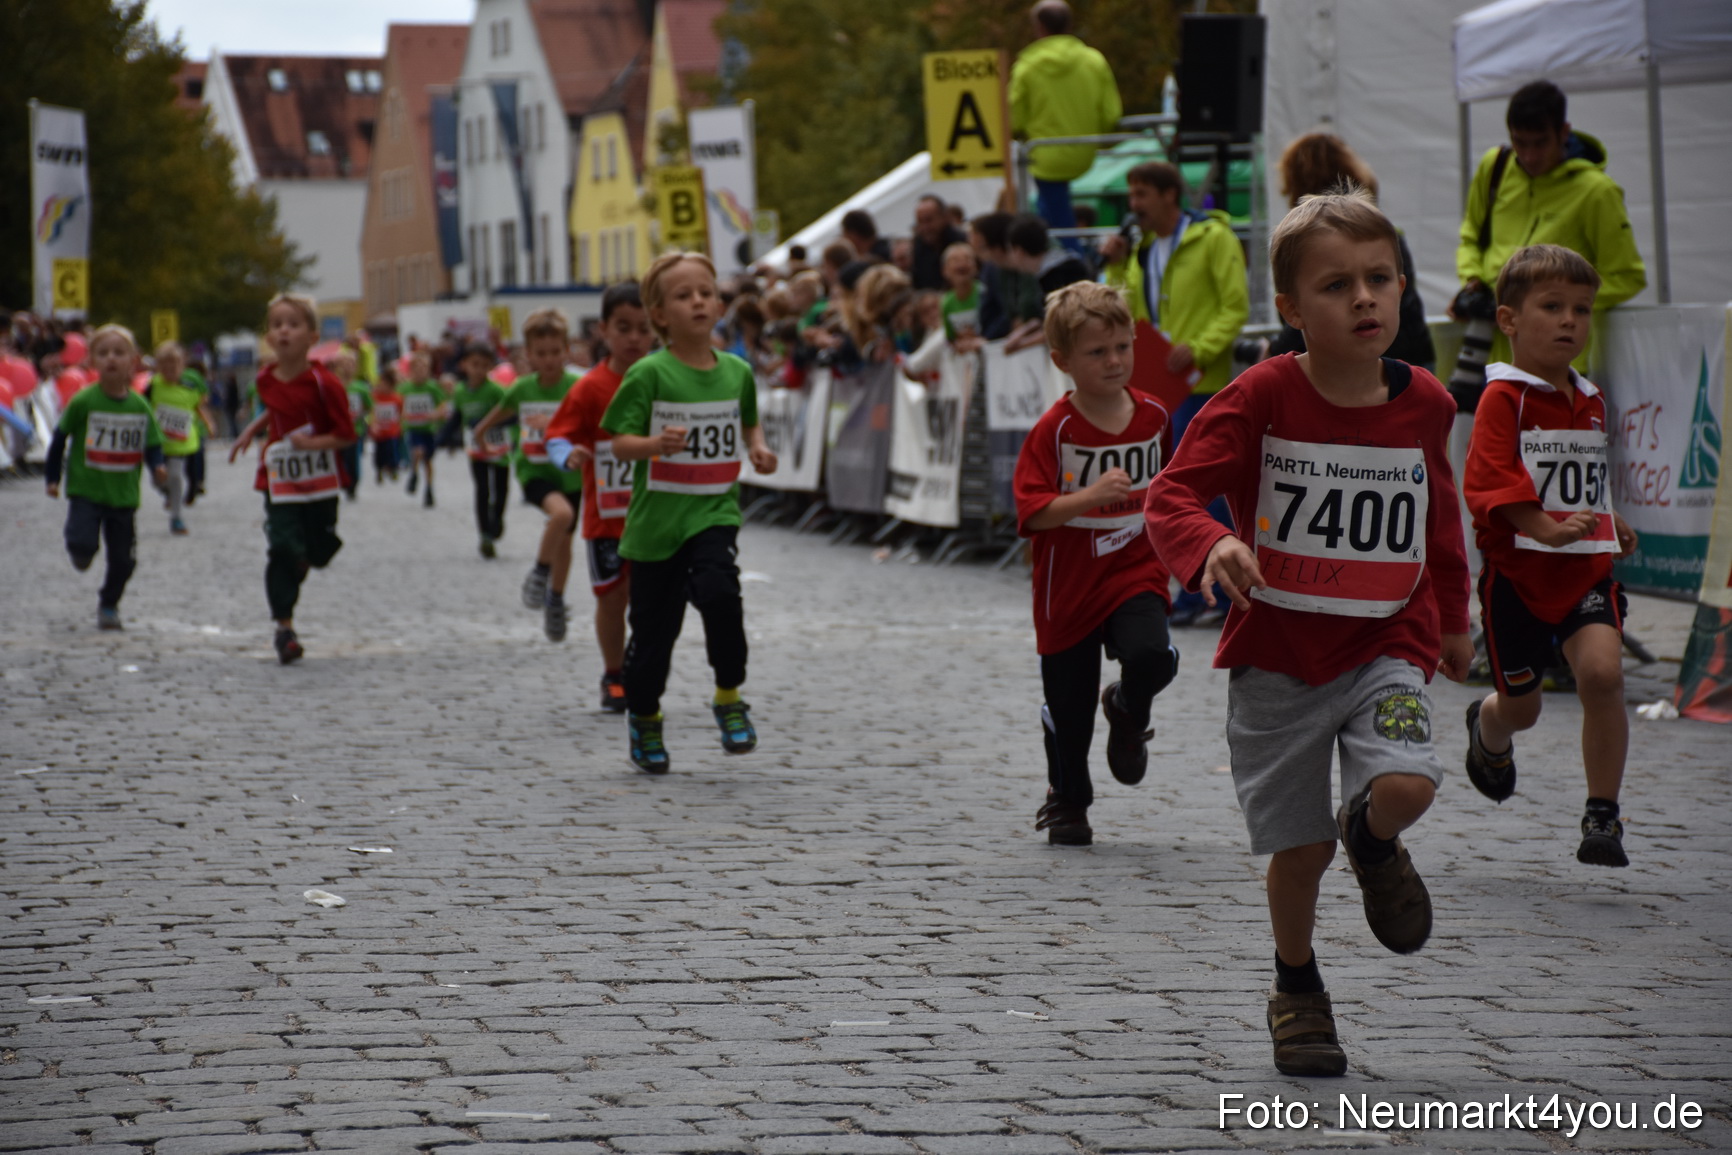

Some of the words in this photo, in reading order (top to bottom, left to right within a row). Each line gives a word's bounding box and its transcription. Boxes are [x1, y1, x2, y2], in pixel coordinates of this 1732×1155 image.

[934, 56, 998, 81] Block
[947, 91, 994, 151] A
[670, 190, 696, 227] B
[59, 271, 77, 298] C
[95, 426, 142, 450] 7190
[661, 423, 736, 459] 439
[1524, 442, 1567, 454] PARTL
[272, 450, 330, 480] 7014
[1264, 453, 1321, 477] PARTL
[1326, 462, 1407, 482] Neumarkt
[1274, 481, 1416, 553] 7400
[1263, 554, 1345, 585] FELIX
